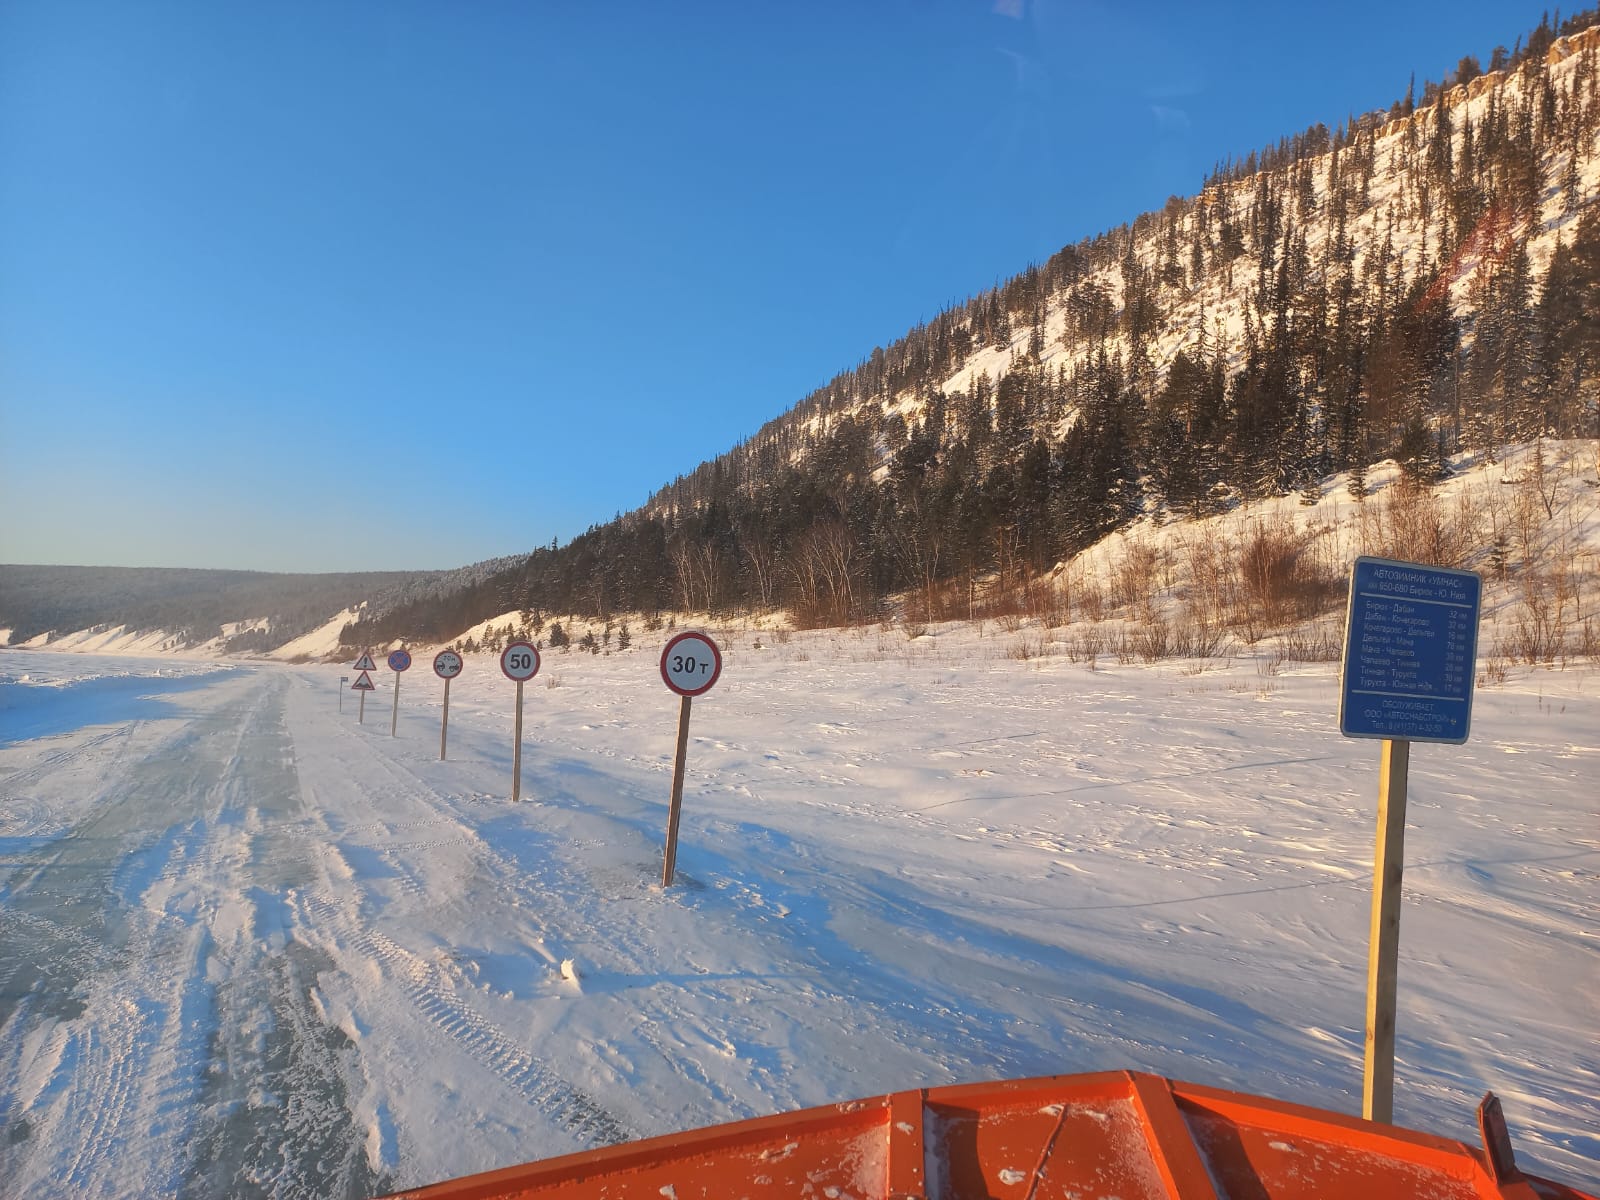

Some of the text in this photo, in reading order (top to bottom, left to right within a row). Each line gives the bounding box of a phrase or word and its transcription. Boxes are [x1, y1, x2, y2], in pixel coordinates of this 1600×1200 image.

[1373, 569, 1426, 584] АВТОЗИМНИК
[510, 654, 531, 670] 50
[672, 655, 695, 673] 30
